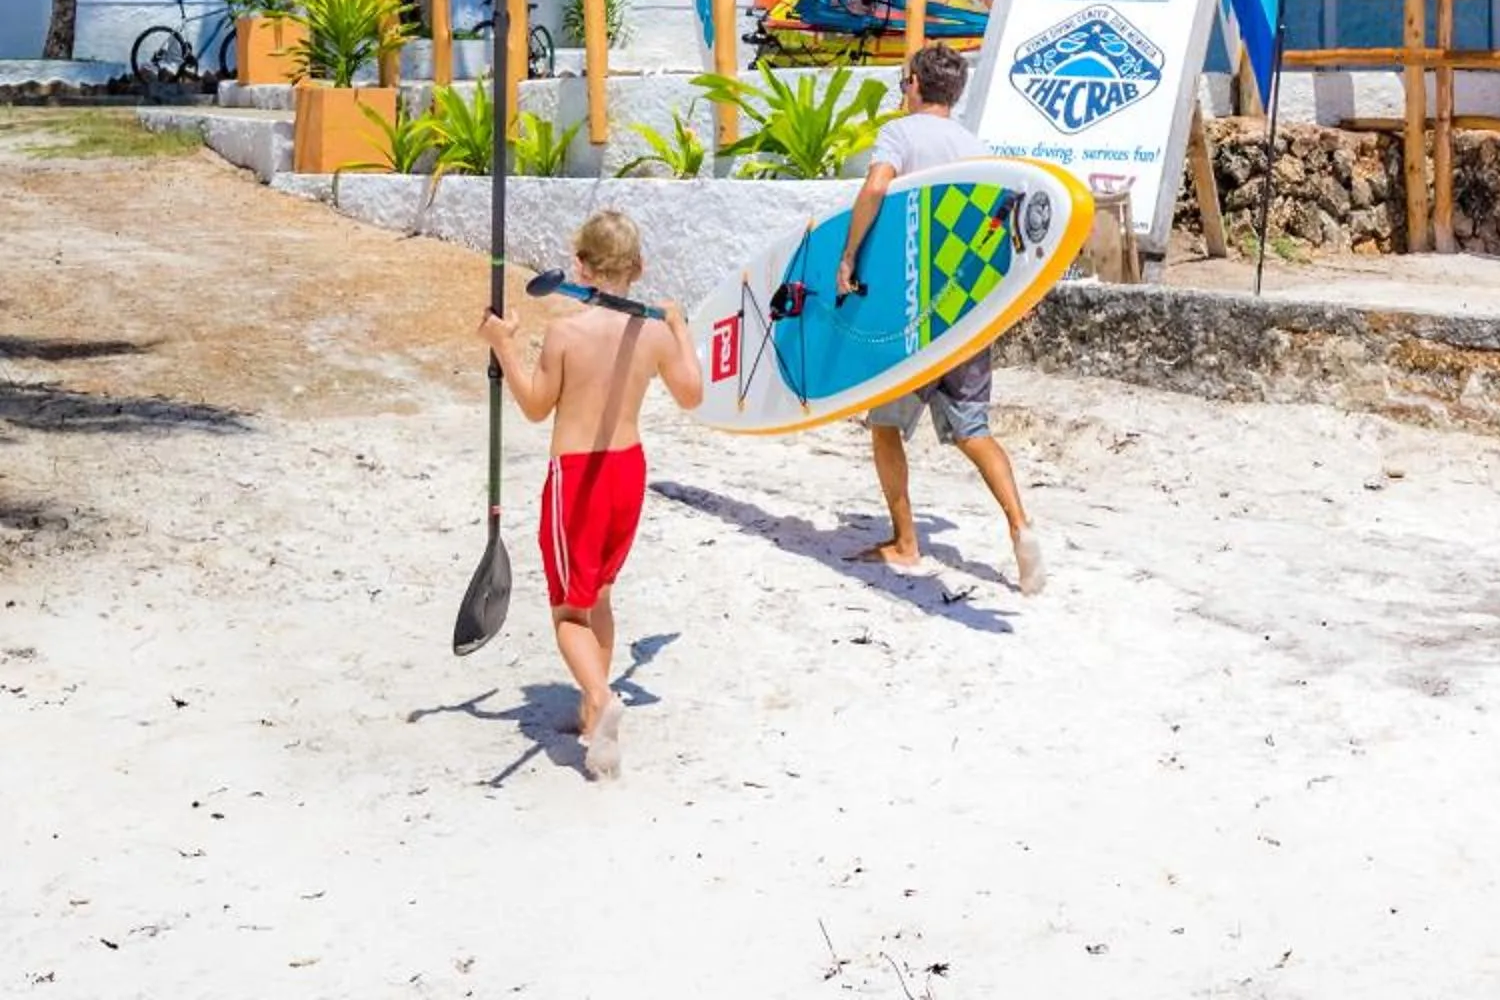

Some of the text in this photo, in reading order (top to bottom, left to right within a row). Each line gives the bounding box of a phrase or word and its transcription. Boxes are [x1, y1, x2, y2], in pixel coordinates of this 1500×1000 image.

[1082, 142, 1129, 161] serious
[1133, 144, 1161, 163] fun!
[904, 187, 919, 357] SNAPPER
